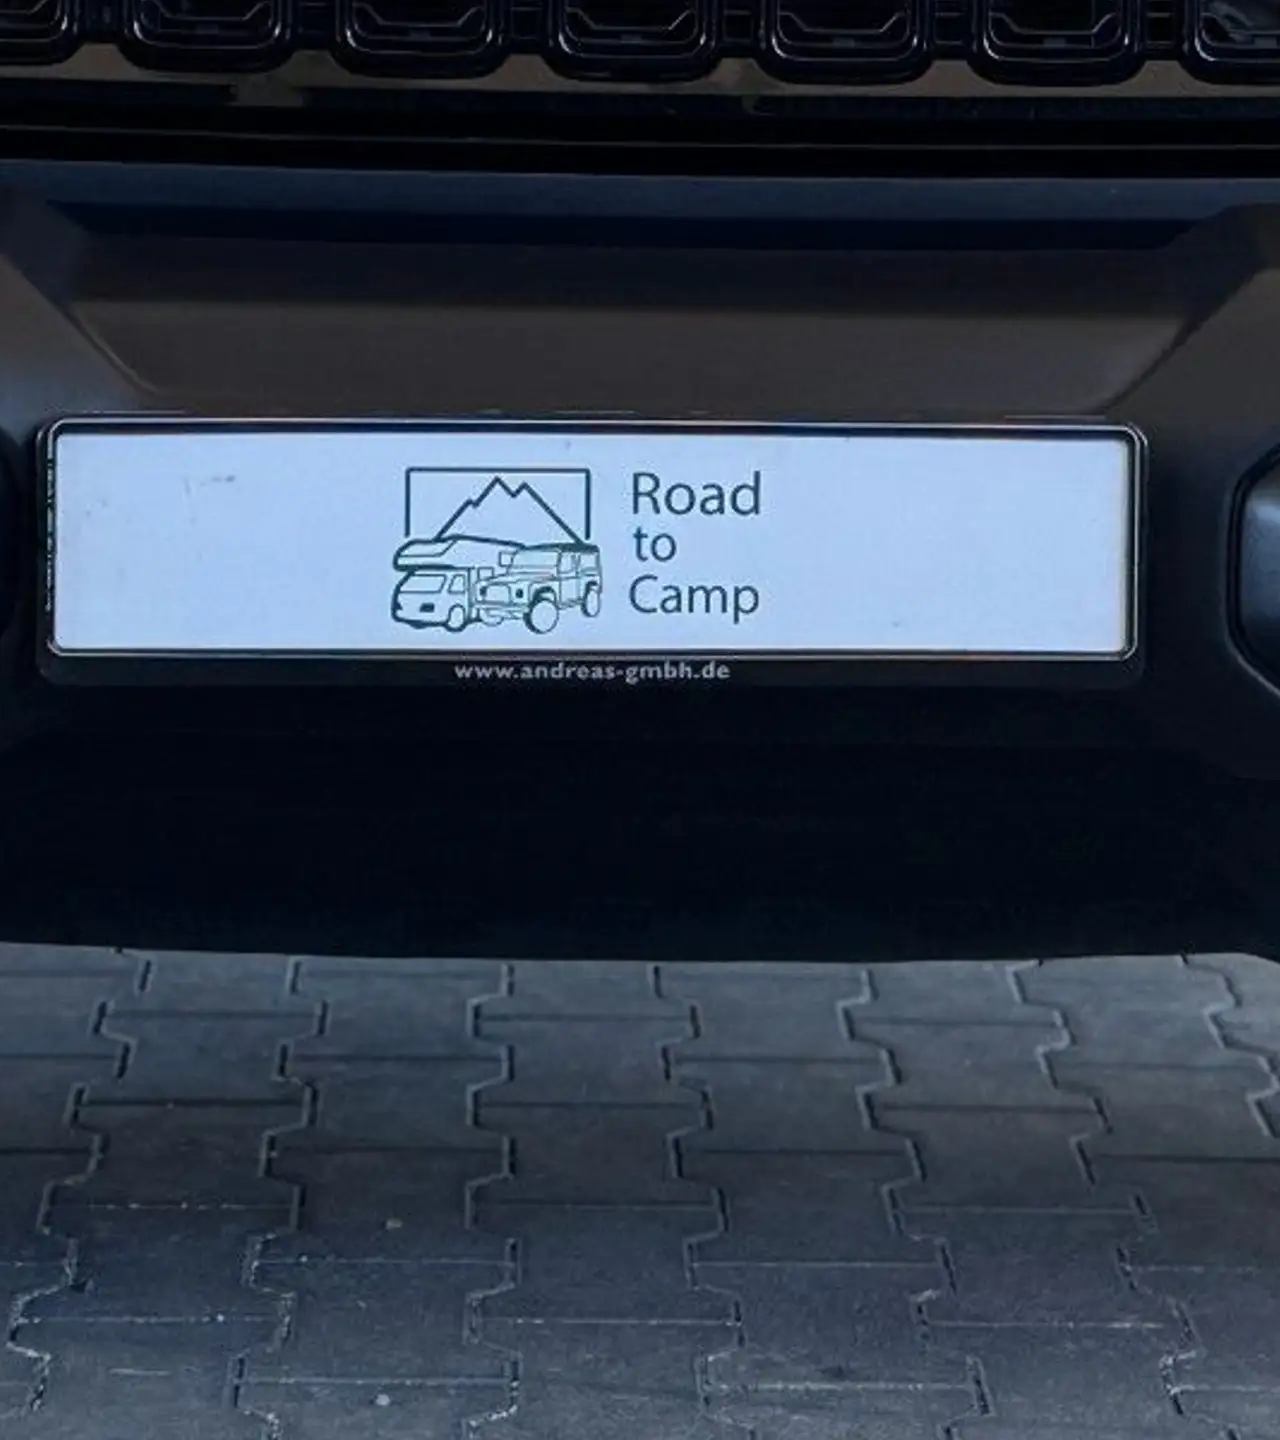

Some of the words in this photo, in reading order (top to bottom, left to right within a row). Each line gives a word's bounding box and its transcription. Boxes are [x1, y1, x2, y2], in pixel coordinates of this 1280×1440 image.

[632, 470, 761, 516] Road
[632, 527, 677, 562] to
[628, 574, 759, 625] Camp
[454, 661, 730, 684] www.andreas-gmbh.de
